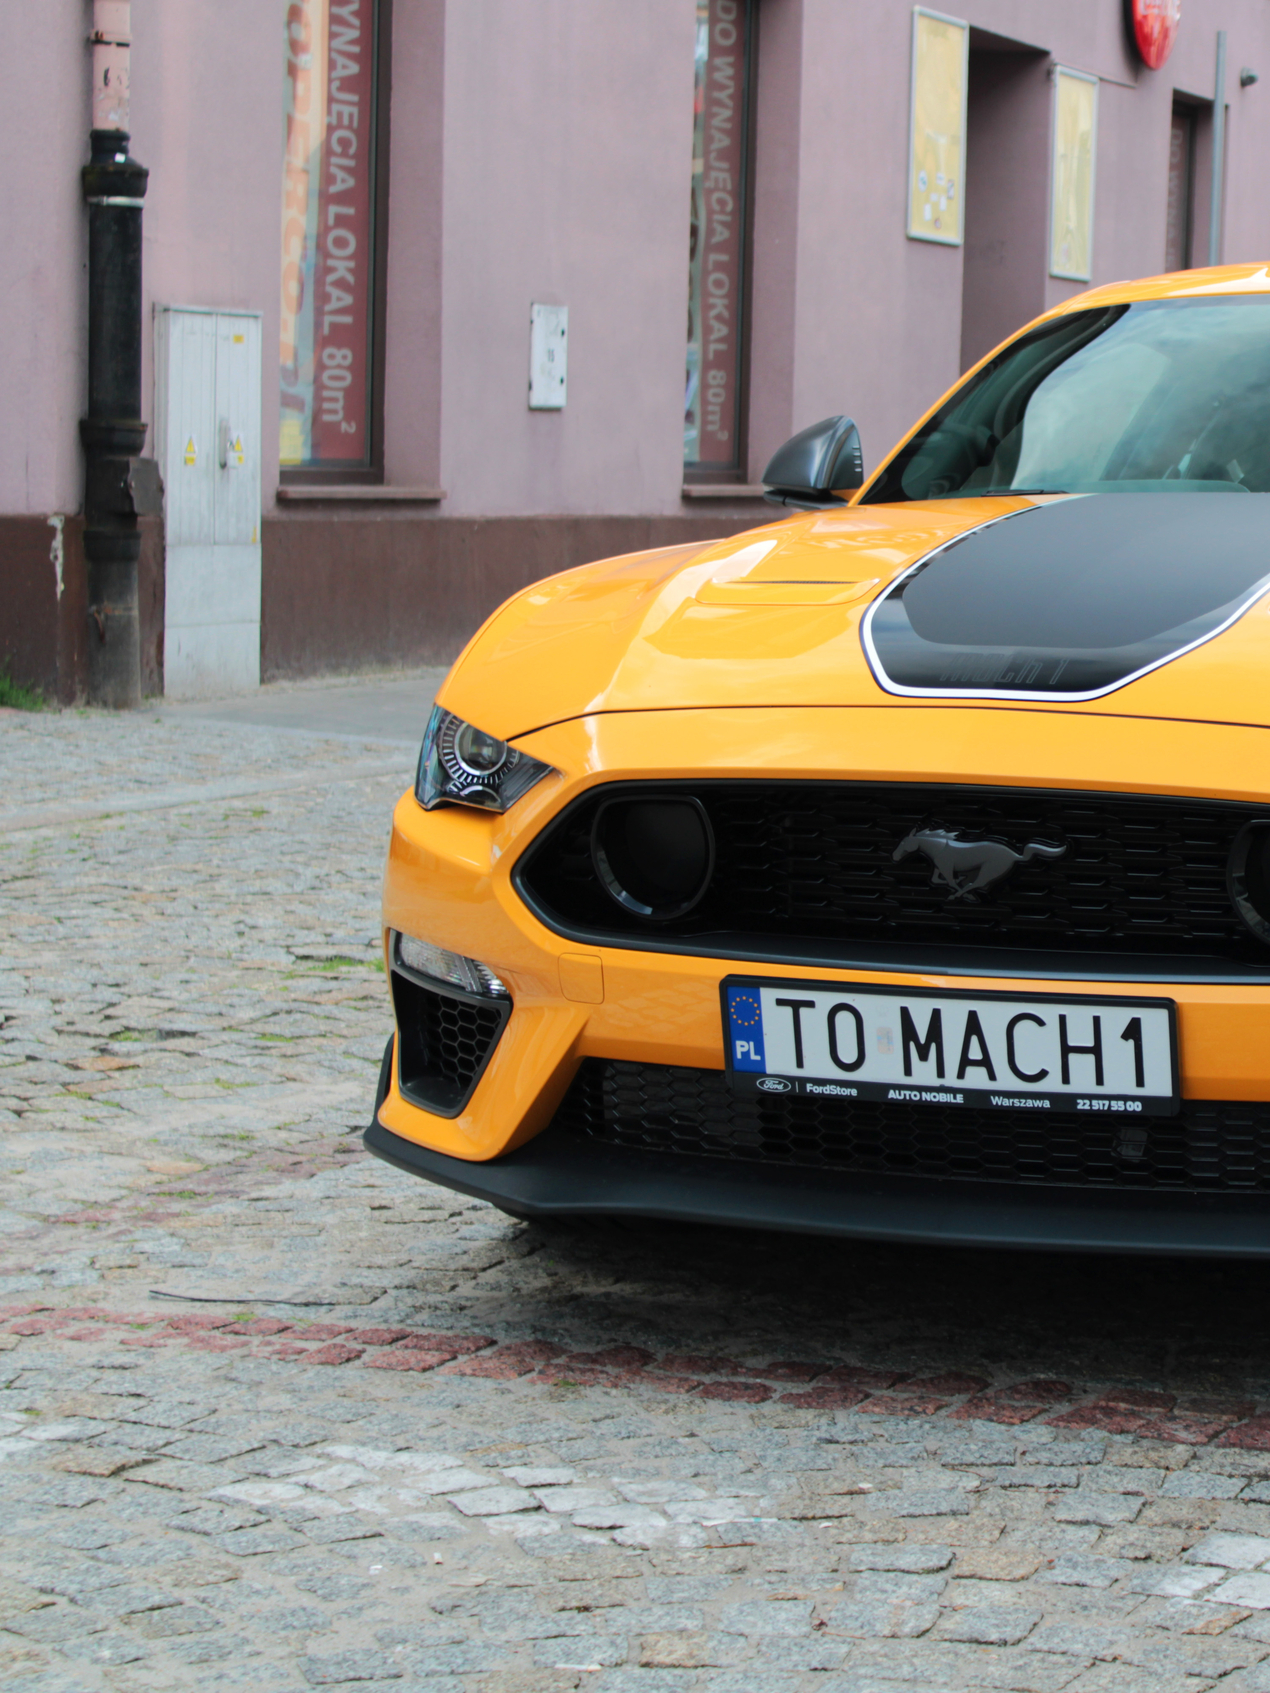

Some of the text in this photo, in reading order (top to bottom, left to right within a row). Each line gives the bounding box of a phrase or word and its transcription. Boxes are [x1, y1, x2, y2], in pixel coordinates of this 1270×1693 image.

[713, 0, 738, 46] DO
[326, 0, 361, 195] YNAJĘCIA
[703, 55, 736, 244] WYNAJĘCIA
[322, 204, 357, 337] LOKAL
[706, 253, 731, 361] LOKAL
[735, 1040, 762, 1061] PL
[775, 997, 1146, 1089] TO MACH1
[763, 1079, 786, 1091] Ford
[806, 1082, 858, 1097] FordStore
[887, 1089, 921, 1101] AUTO
[921, 1091, 964, 1104] NOBILE
[990, 1095, 1051, 1108] Warszawa
[1077, 1099, 1091, 1110] 22
